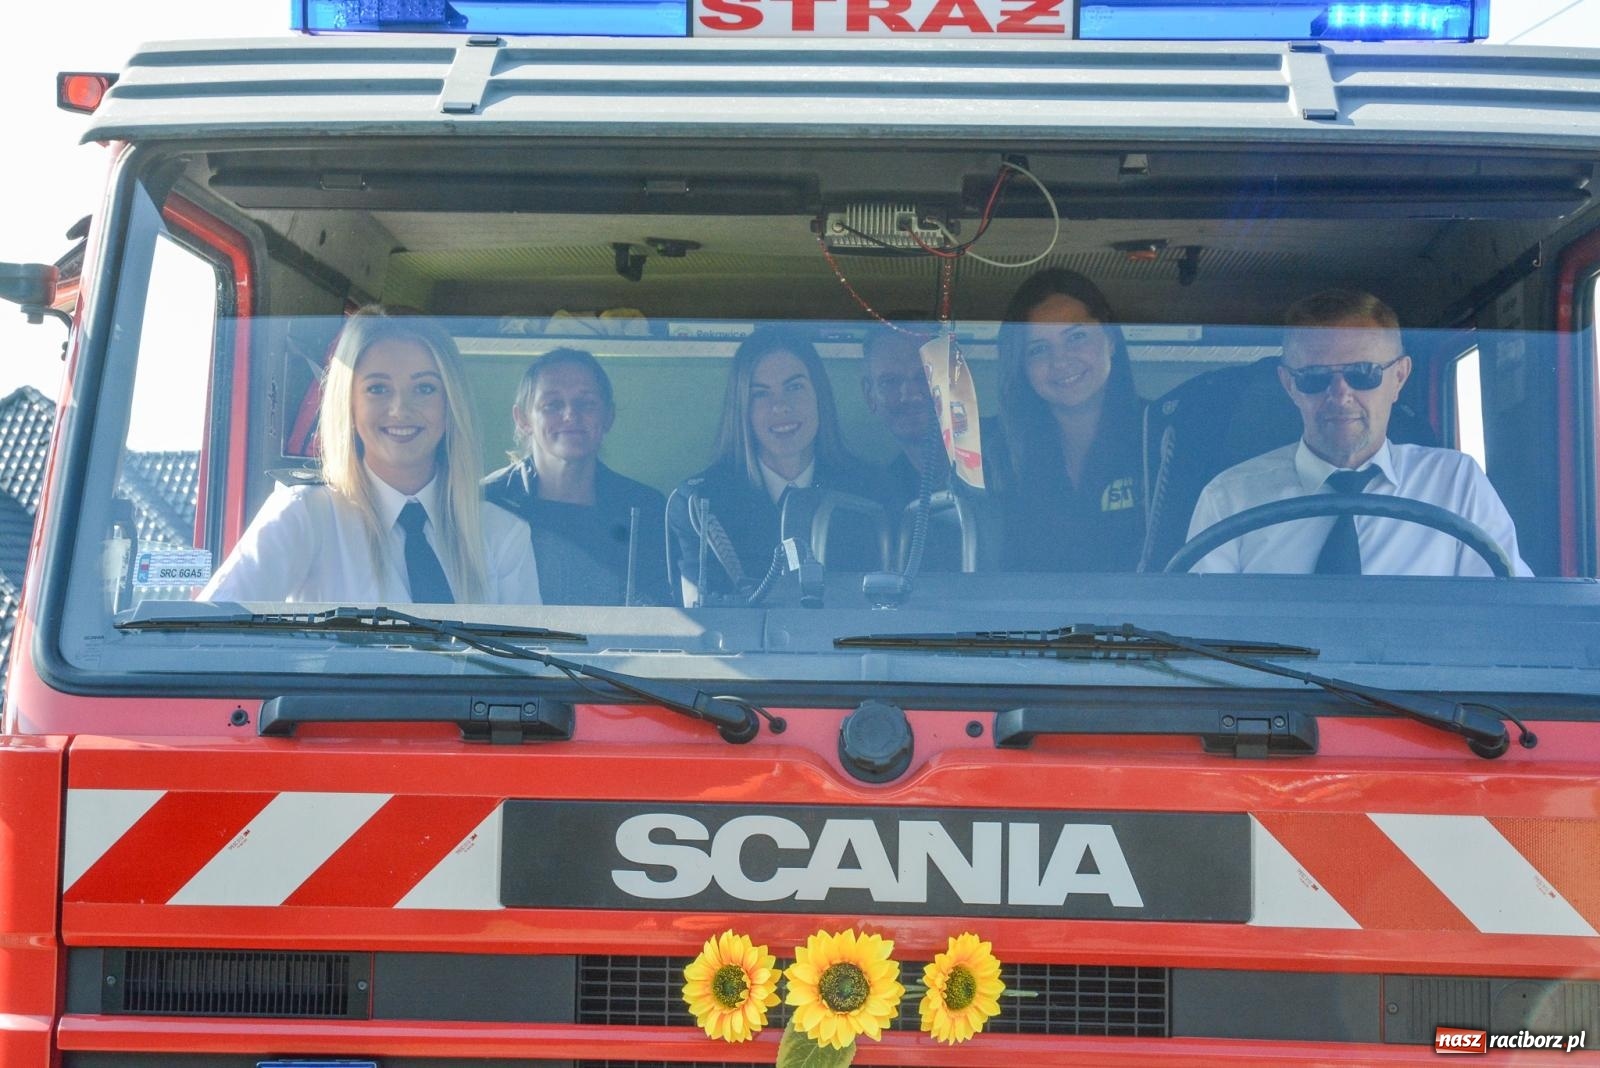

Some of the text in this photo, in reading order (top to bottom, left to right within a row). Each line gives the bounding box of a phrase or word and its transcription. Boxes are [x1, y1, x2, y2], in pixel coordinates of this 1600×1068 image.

[160, 568, 177, 578] SRC
[179, 568, 202, 578] 6GA5
[611, 813, 1144, 907] SCANIA
